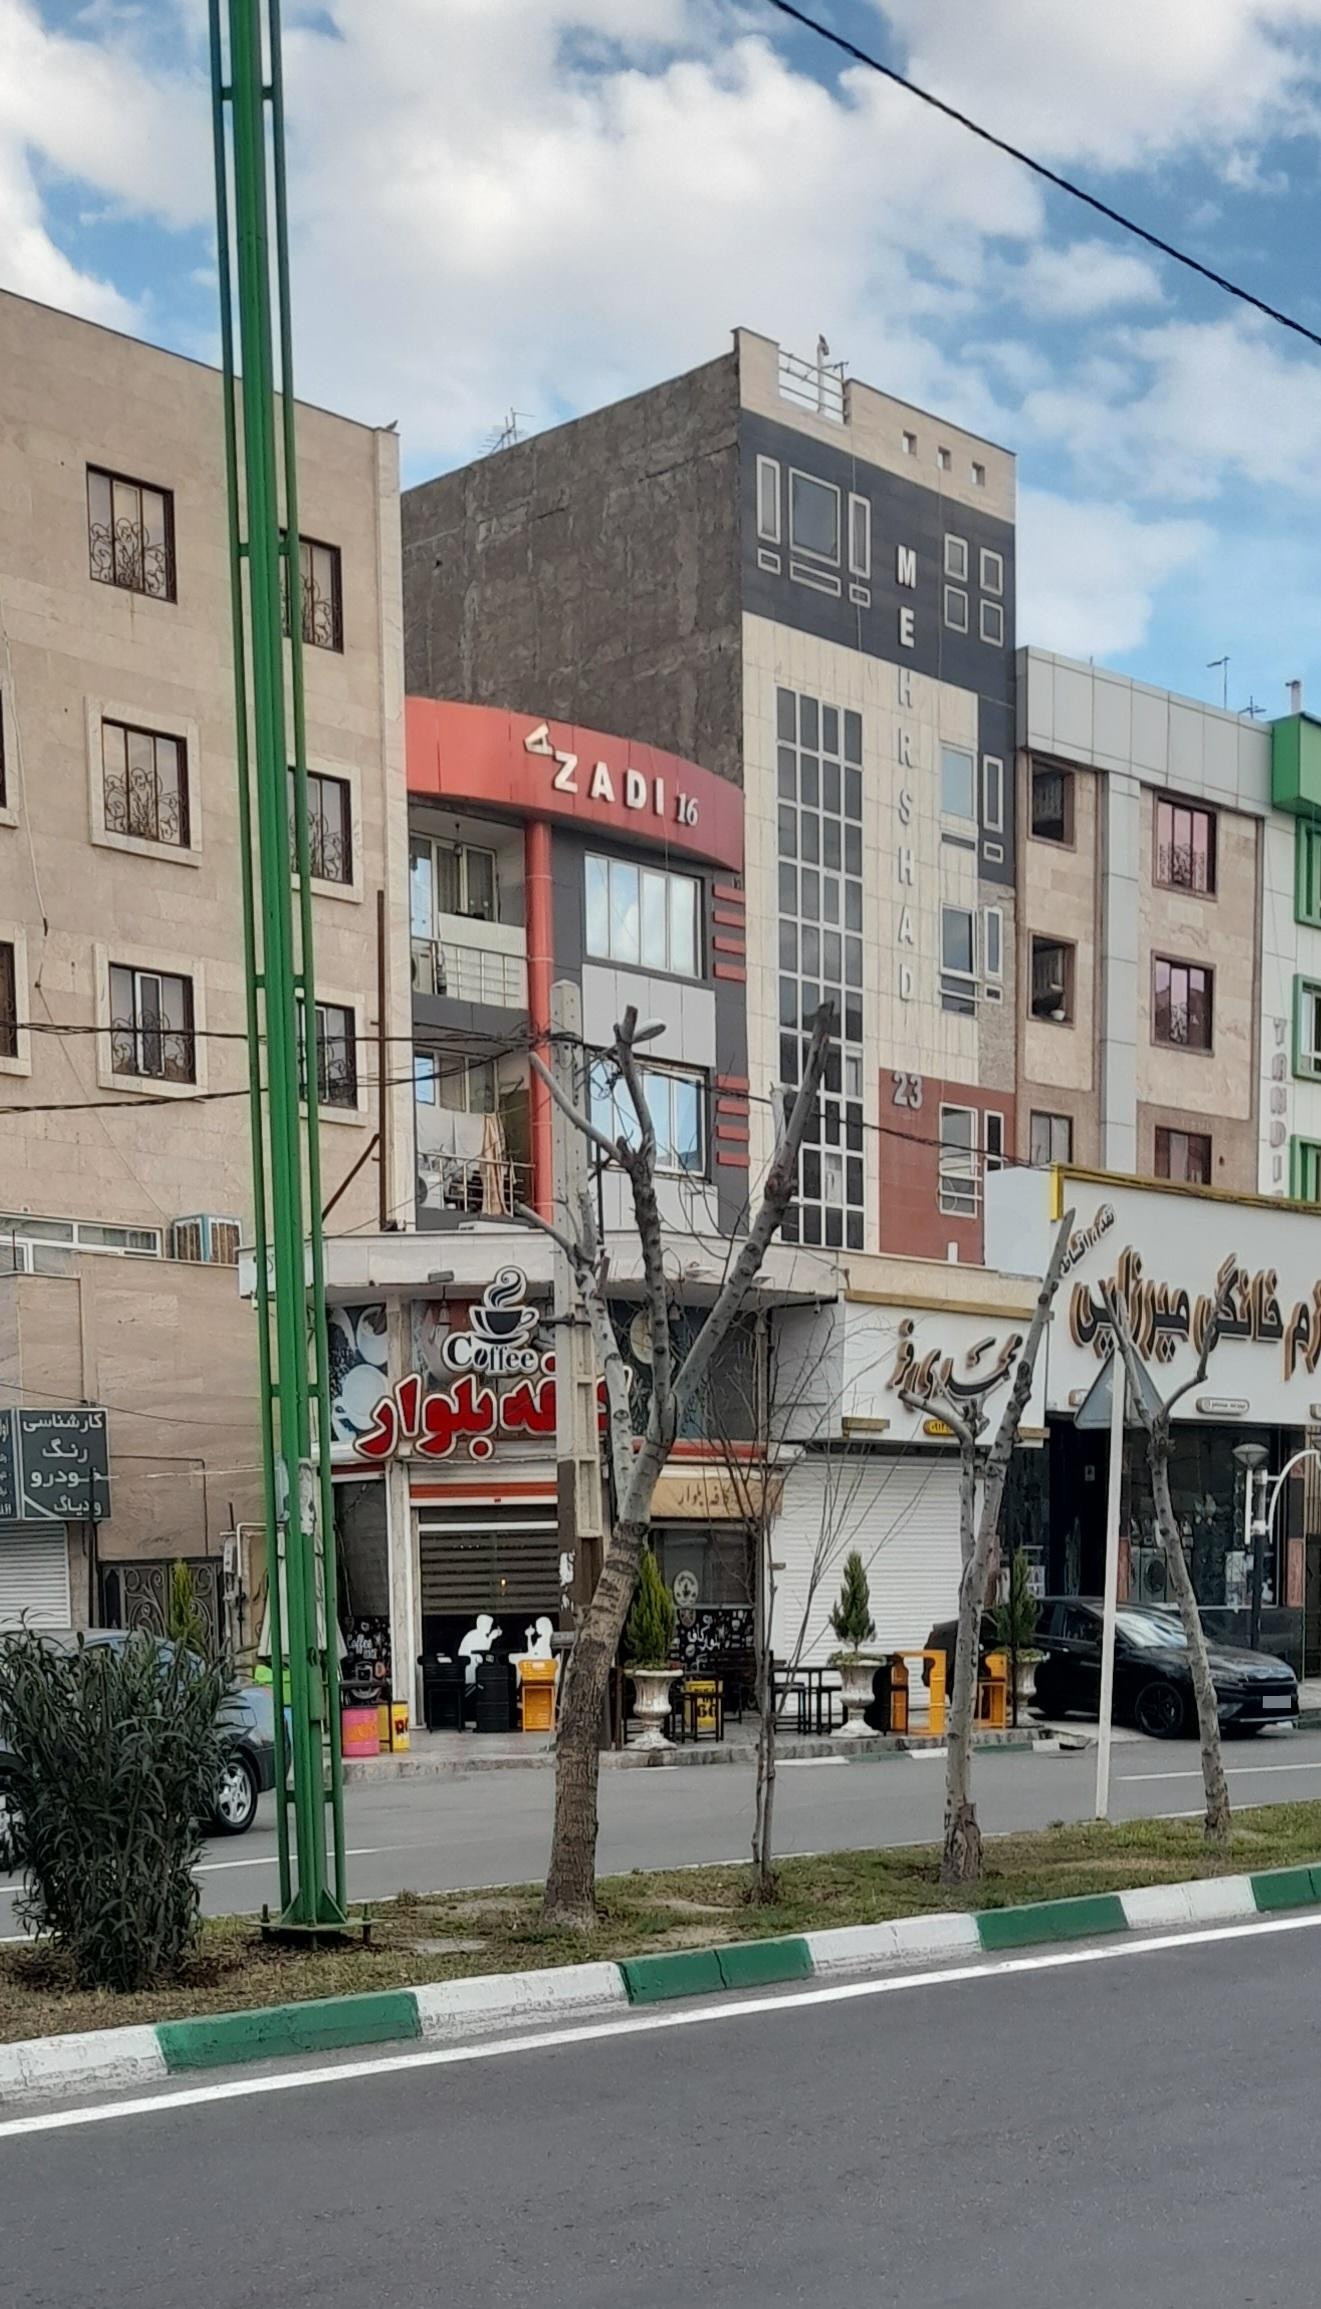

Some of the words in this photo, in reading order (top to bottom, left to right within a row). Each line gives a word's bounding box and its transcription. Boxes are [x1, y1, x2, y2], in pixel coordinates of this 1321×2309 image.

[523, 722, 665, 816] AZADI
[676, 791, 699, 827] 16
[897, 544, 917, 1001] MEHRSHAD
[892, 1071, 924, 1110] 23
[1068, 1244, 1190, 1364] میرزایی
[1192, 1251, 1284, 1355] خانگی
[443, 1332, 538, 1376] Coffee
[23, 1412, 104, 1433] کارشناسی
[41, 1437, 89, 1463] رنگ
[354, 1373, 498, 1461] بلوار
[30, 1466, 103, 1488] خودرو
